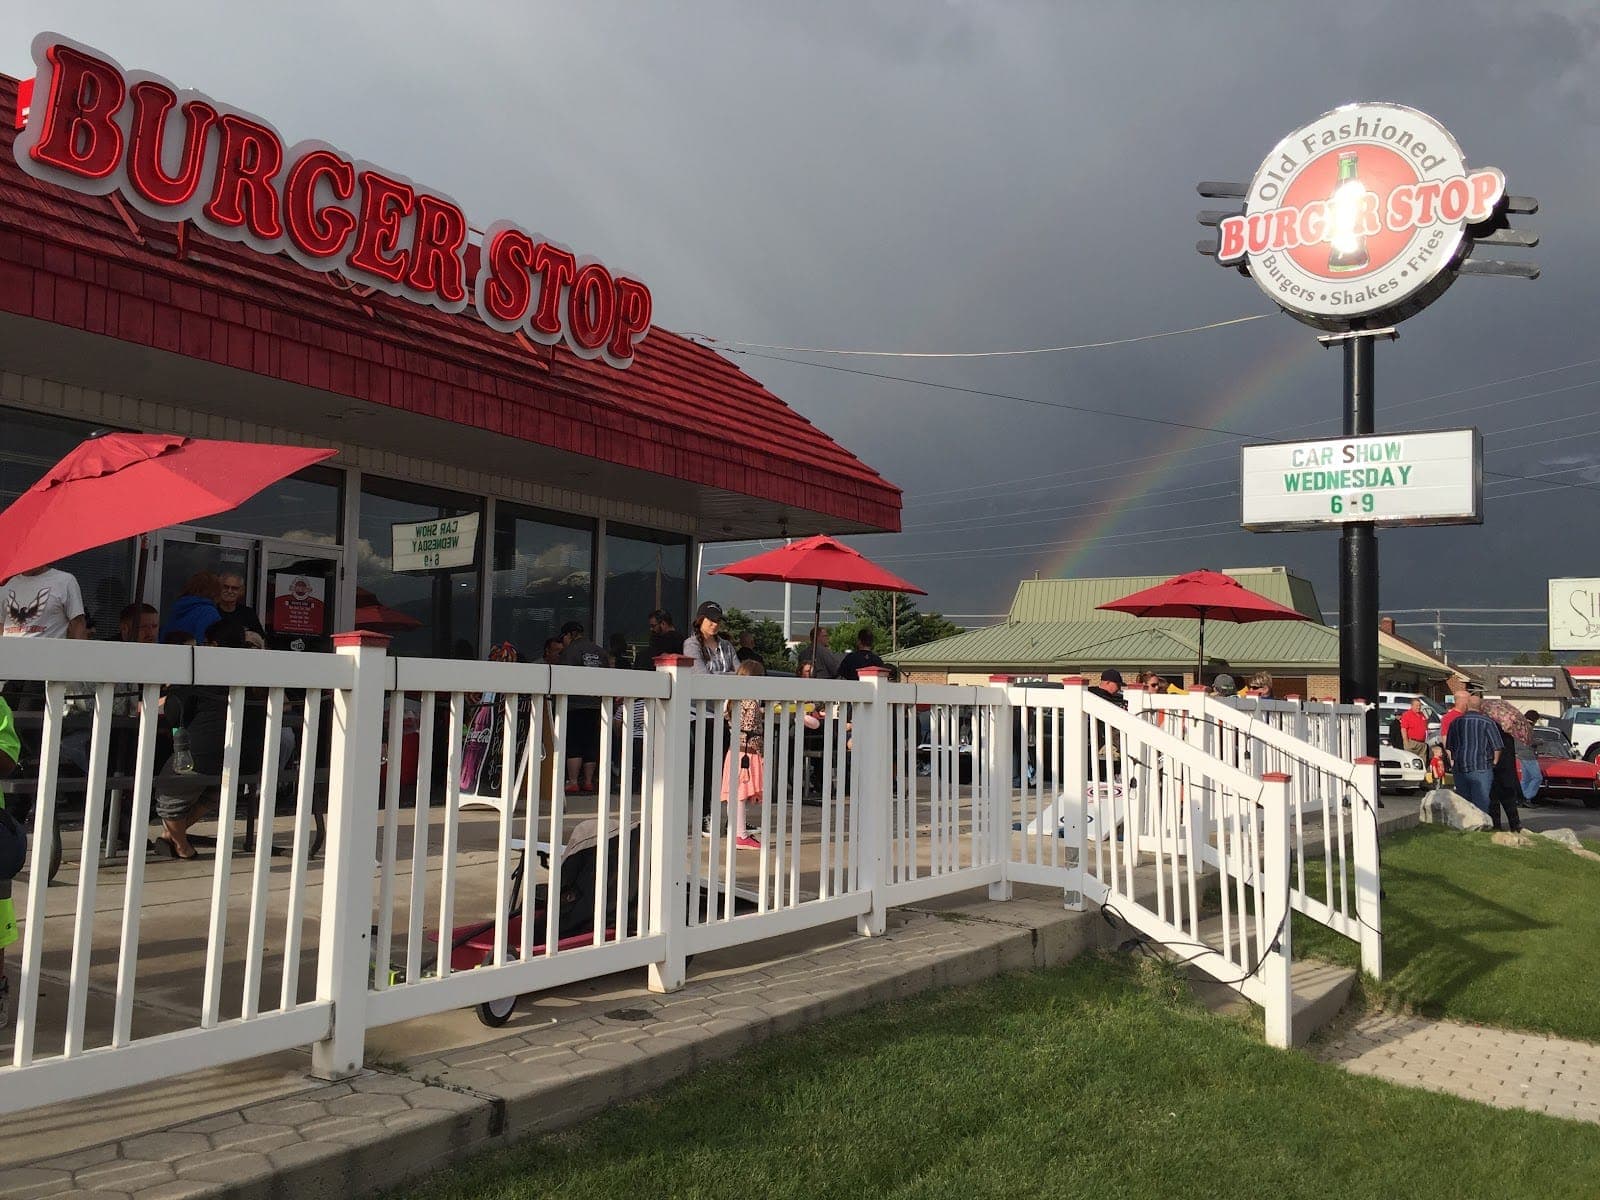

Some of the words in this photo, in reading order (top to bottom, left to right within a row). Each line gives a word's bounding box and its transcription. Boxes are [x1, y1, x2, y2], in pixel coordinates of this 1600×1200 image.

[1259, 154, 1297, 201] Old
[1302, 117, 1446, 172] Fashioned
[30, 44, 466, 301] BURGER
[485, 228, 652, 359] STOP
[1219, 192, 1381, 258] BURGR
[1391, 174, 1498, 225] STOP
[1262, 254, 1314, 303] Burgers
[1330, 278, 1399, 306] Shakes
[1406, 227, 1444, 273] Fries
[1284, 465, 1412, 491] WEDNESDAY
[1292, 447, 1334, 467] CAR
[1342, 442, 1401, 464] SHOW
